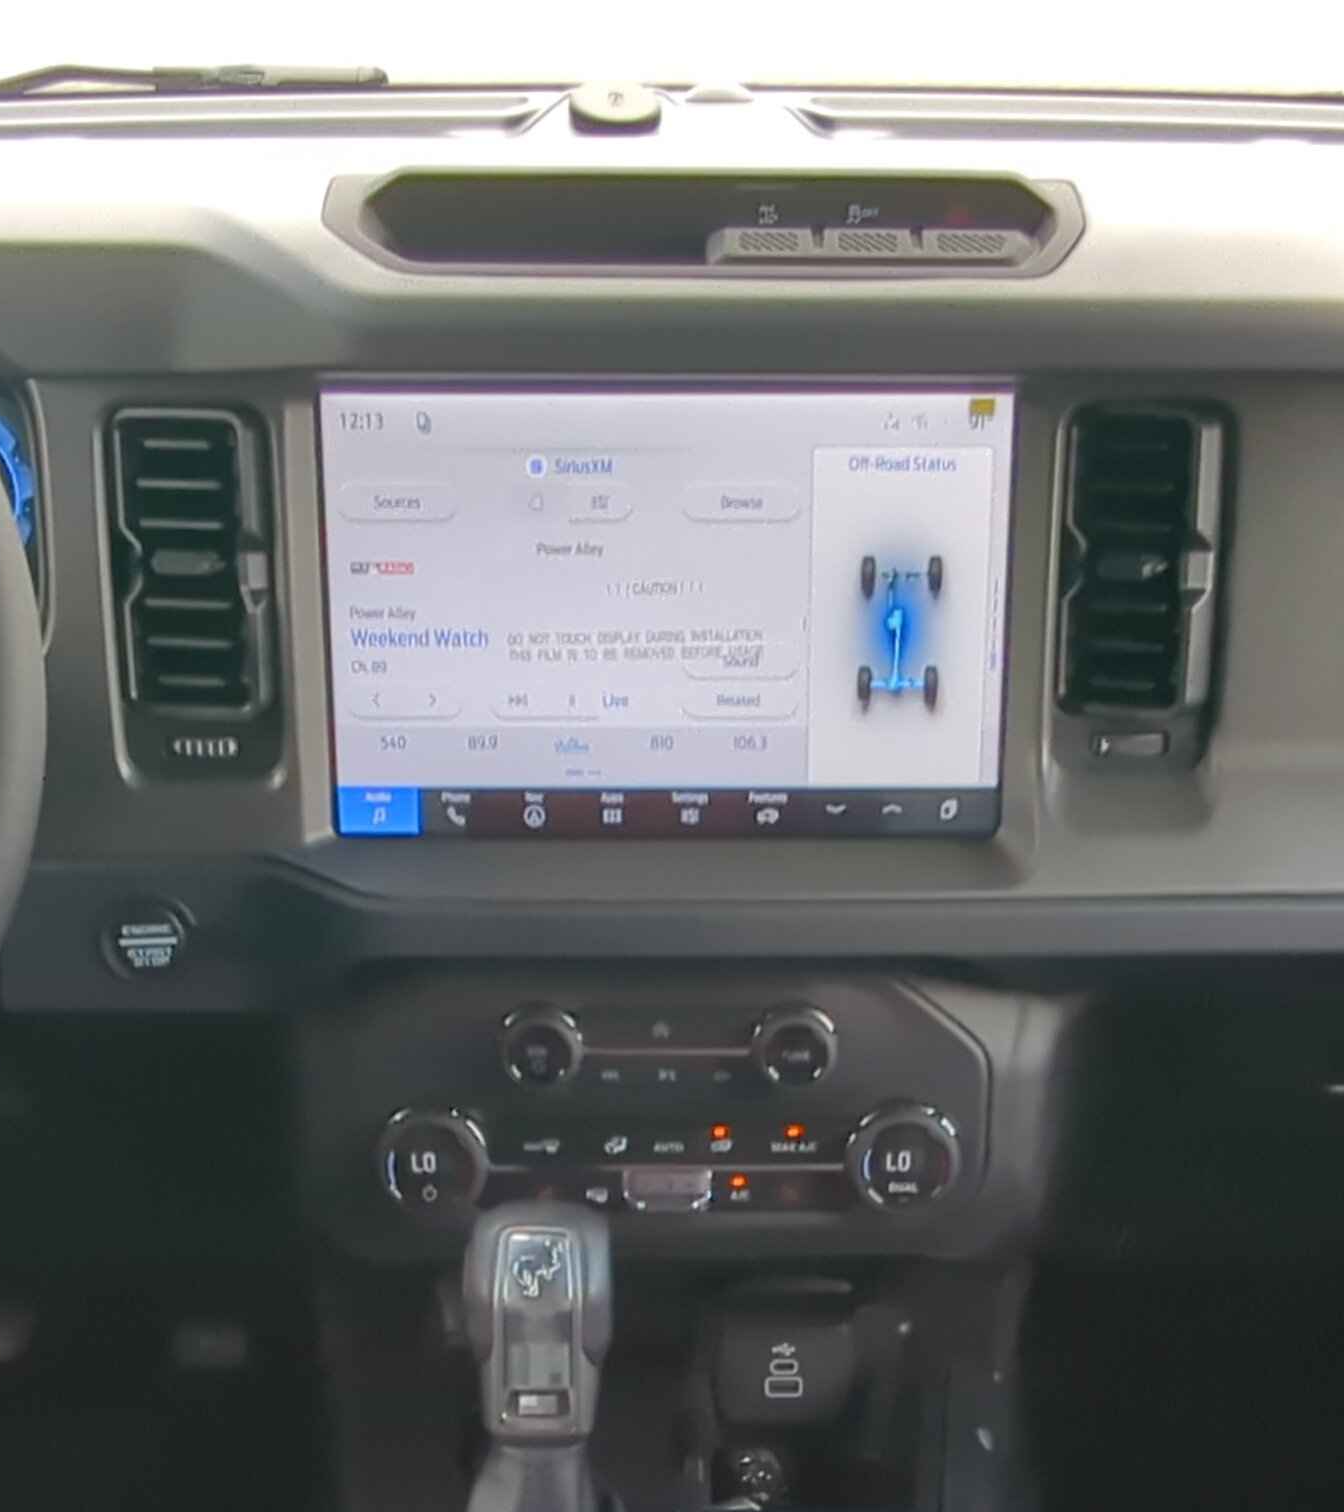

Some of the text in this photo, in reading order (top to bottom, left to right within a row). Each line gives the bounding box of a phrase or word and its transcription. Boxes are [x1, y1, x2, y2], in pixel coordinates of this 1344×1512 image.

[339, 412, 384, 430] 12:13
[554, 457, 613, 474] SiriusXM
[848, 456, 957, 472] Off-Road Status
[373, 494, 421, 511] Sources
[720, 494, 763, 511] Browse
[536, 542, 572, 556] Power
[349, 606, 416, 622] Power Alley
[350, 628, 490, 648] Weekend Watch
[602, 694, 629, 708] Live
[379, 735, 407, 751] 540
[653, 1142, 684, 1153] AUTO
[410, 1151, 437, 1174] LO
[885, 1149, 911, 1173] LO
